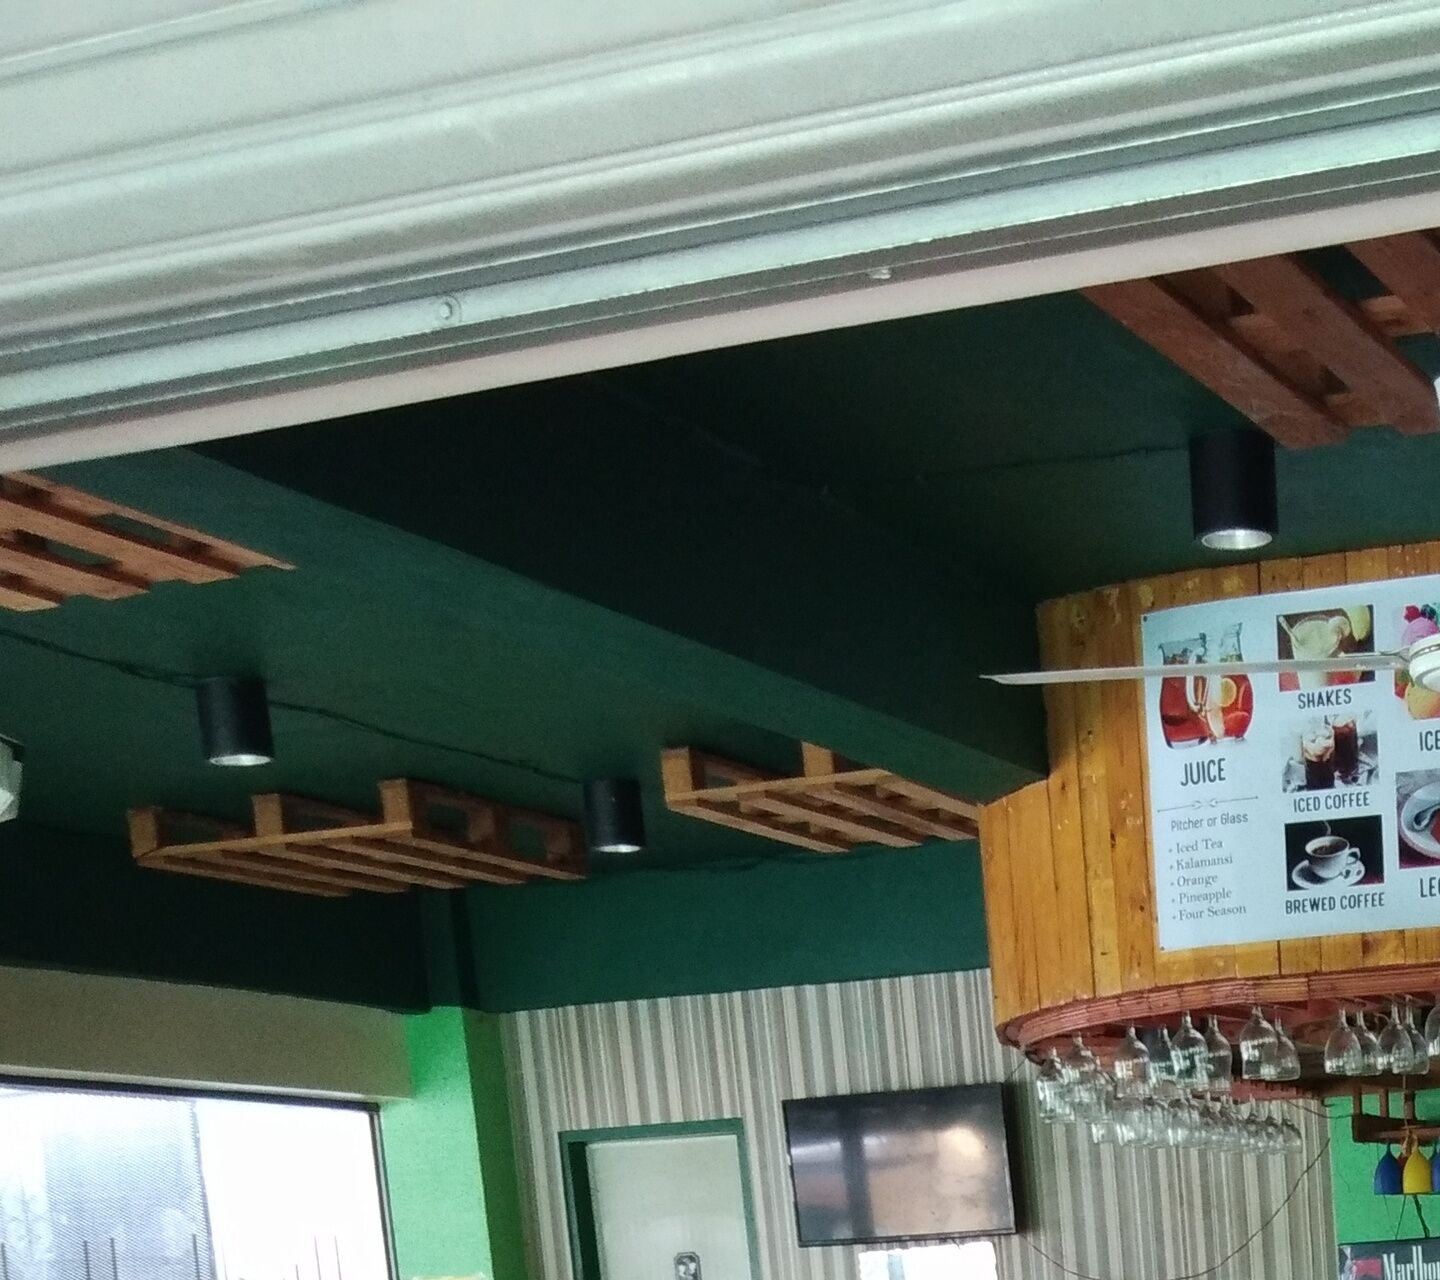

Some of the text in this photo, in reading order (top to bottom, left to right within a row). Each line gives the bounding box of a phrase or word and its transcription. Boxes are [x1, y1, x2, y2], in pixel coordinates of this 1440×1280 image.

[1298, 688, 1352, 710] SHAKES
[1180, 758, 1226, 786] JUICE
[1294, 792, 1370, 813] ICED COFFEE
[1171, 812, 1248, 832] Pitcher or Glass
[1176, 838, 1223, 854] Iced Tea
[1176, 854, 1233, 871] Kalamansi
[1177, 874, 1218, 888] Orange
[1178, 888, 1232, 905] Pineapple
[1285, 892, 1386, 914] BREWED COFFEE
[1178, 904, 1246, 920] Four Season
